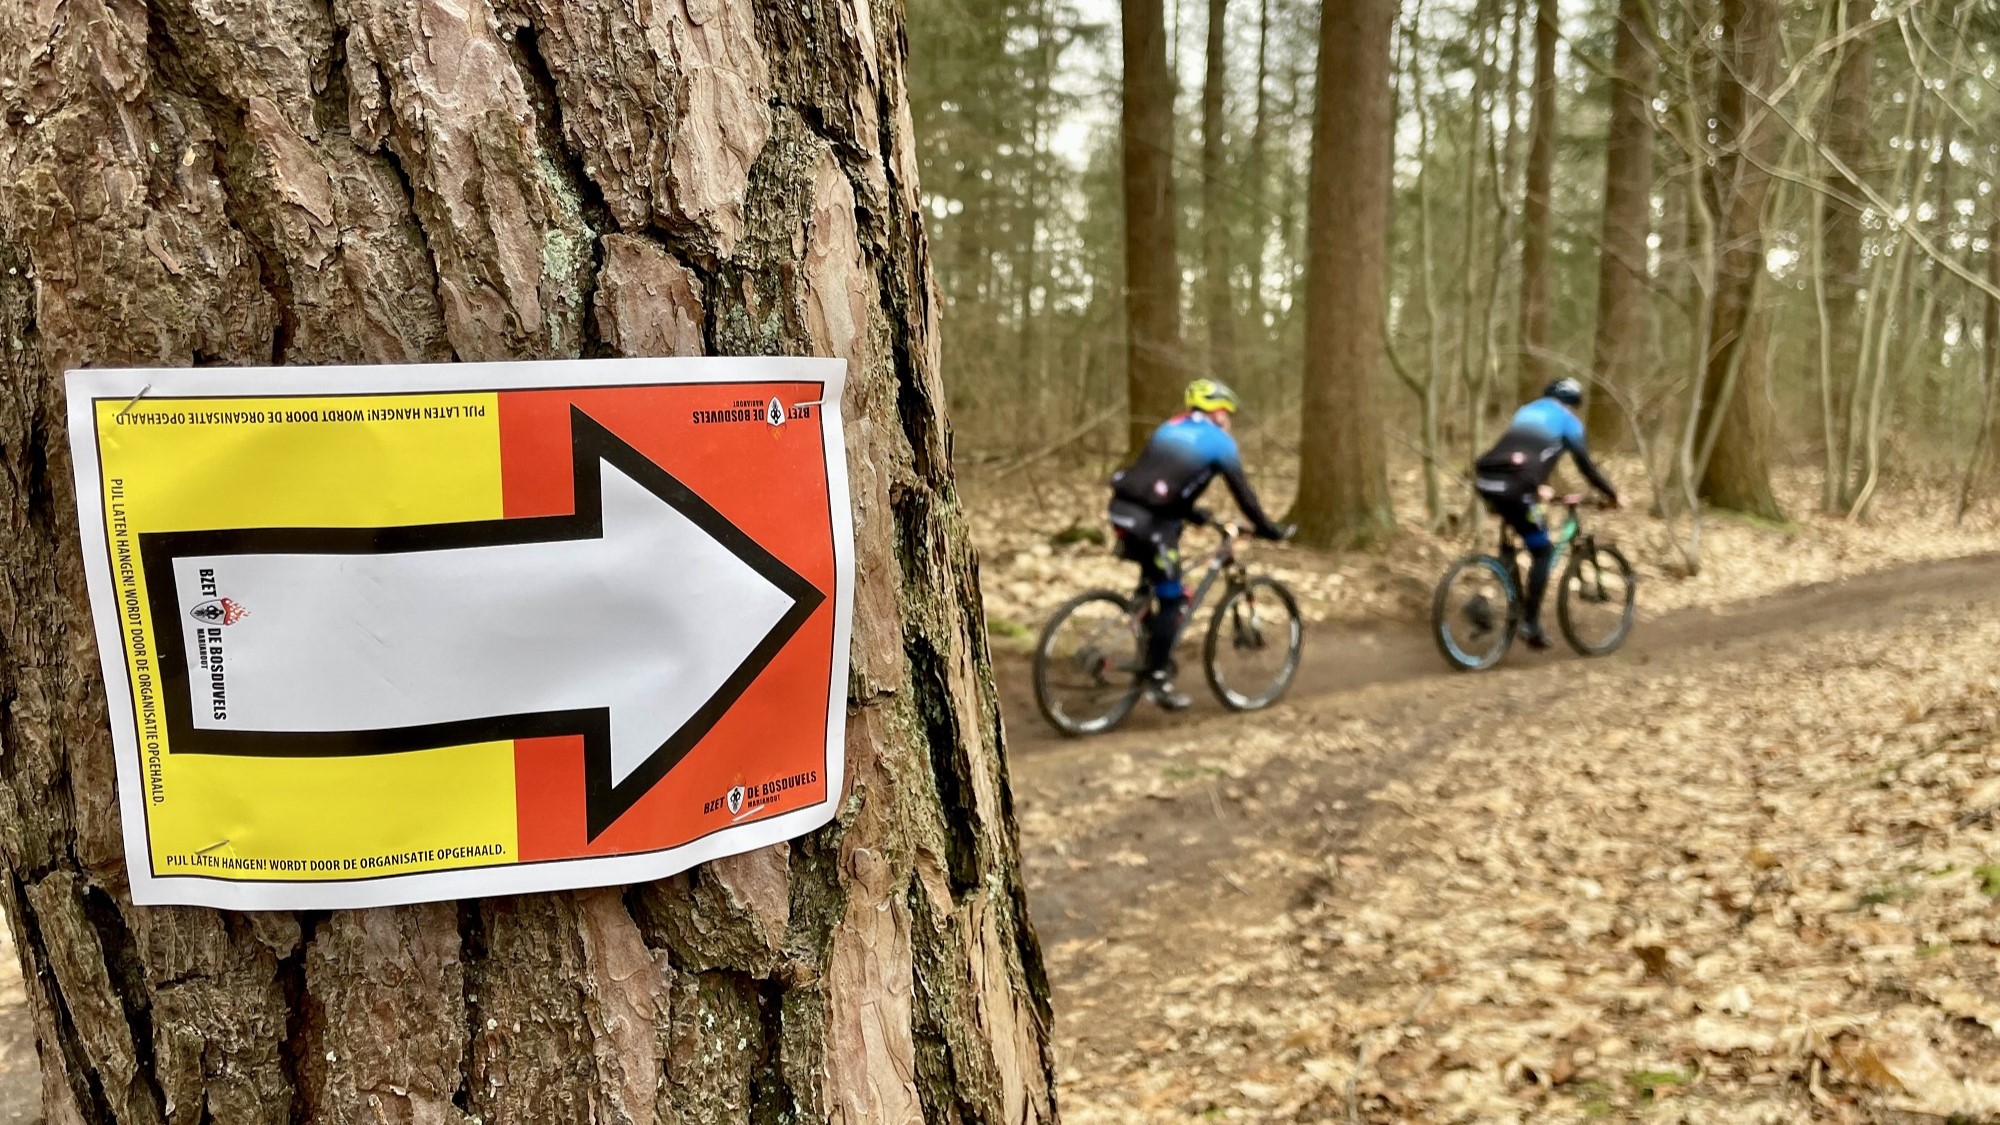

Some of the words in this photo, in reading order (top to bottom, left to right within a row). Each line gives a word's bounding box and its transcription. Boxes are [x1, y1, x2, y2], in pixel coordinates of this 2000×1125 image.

[112, 412, 185, 425] OPGEHAALD.
[188, 411, 265, 425] ORGANISATIE
[268, 411, 282, 423] DE
[286, 410, 318, 423] DOOR
[322, 410, 364, 422] WORDT
[367, 408, 421, 421] HANGEN!
[424, 406, 459, 419] LATEN
[463, 405, 485, 417] PIJL
[693, 409, 750, 424] BOSDUVELS
[753, 409, 764, 421] DE
[788, 407, 810, 419] BZET
[111, 478, 123, 501] PIJL
[112, 503, 127, 537] LATEN
[116, 539, 135, 587] HANGEN!
[199, 568, 217, 597] BZET
[124, 589, 142, 626] WORDT
[131, 628, 147, 657] DOOR
[207, 628, 222, 643] DE
[196, 628, 208, 669] MARIAHOUT
[135, 659, 149, 672] DE
[209, 647, 227, 720] BOSDUVELS
[138, 674, 158, 740] ORGANISATIE
[147, 742, 164, 806] OPGEHAALD.
[704, 796, 725, 814] BZET
[747, 785, 759, 799] DE
[762, 770, 817, 795] BOSDUVELS
[747, 794, 781, 808] MARIAHOUT
[167, 855, 188, 866] PIJL
[191, 855, 220, 868] LATEN
[222, 857, 267, 870] HANGEN!
[269, 859, 307, 871] WORDT
[310, 859, 340, 871] DOOR
[343, 859, 357, 870] DE
[360, 850, 434, 868] ORGANISATIE
[437, 844, 506, 860] OPGEHAALD.
